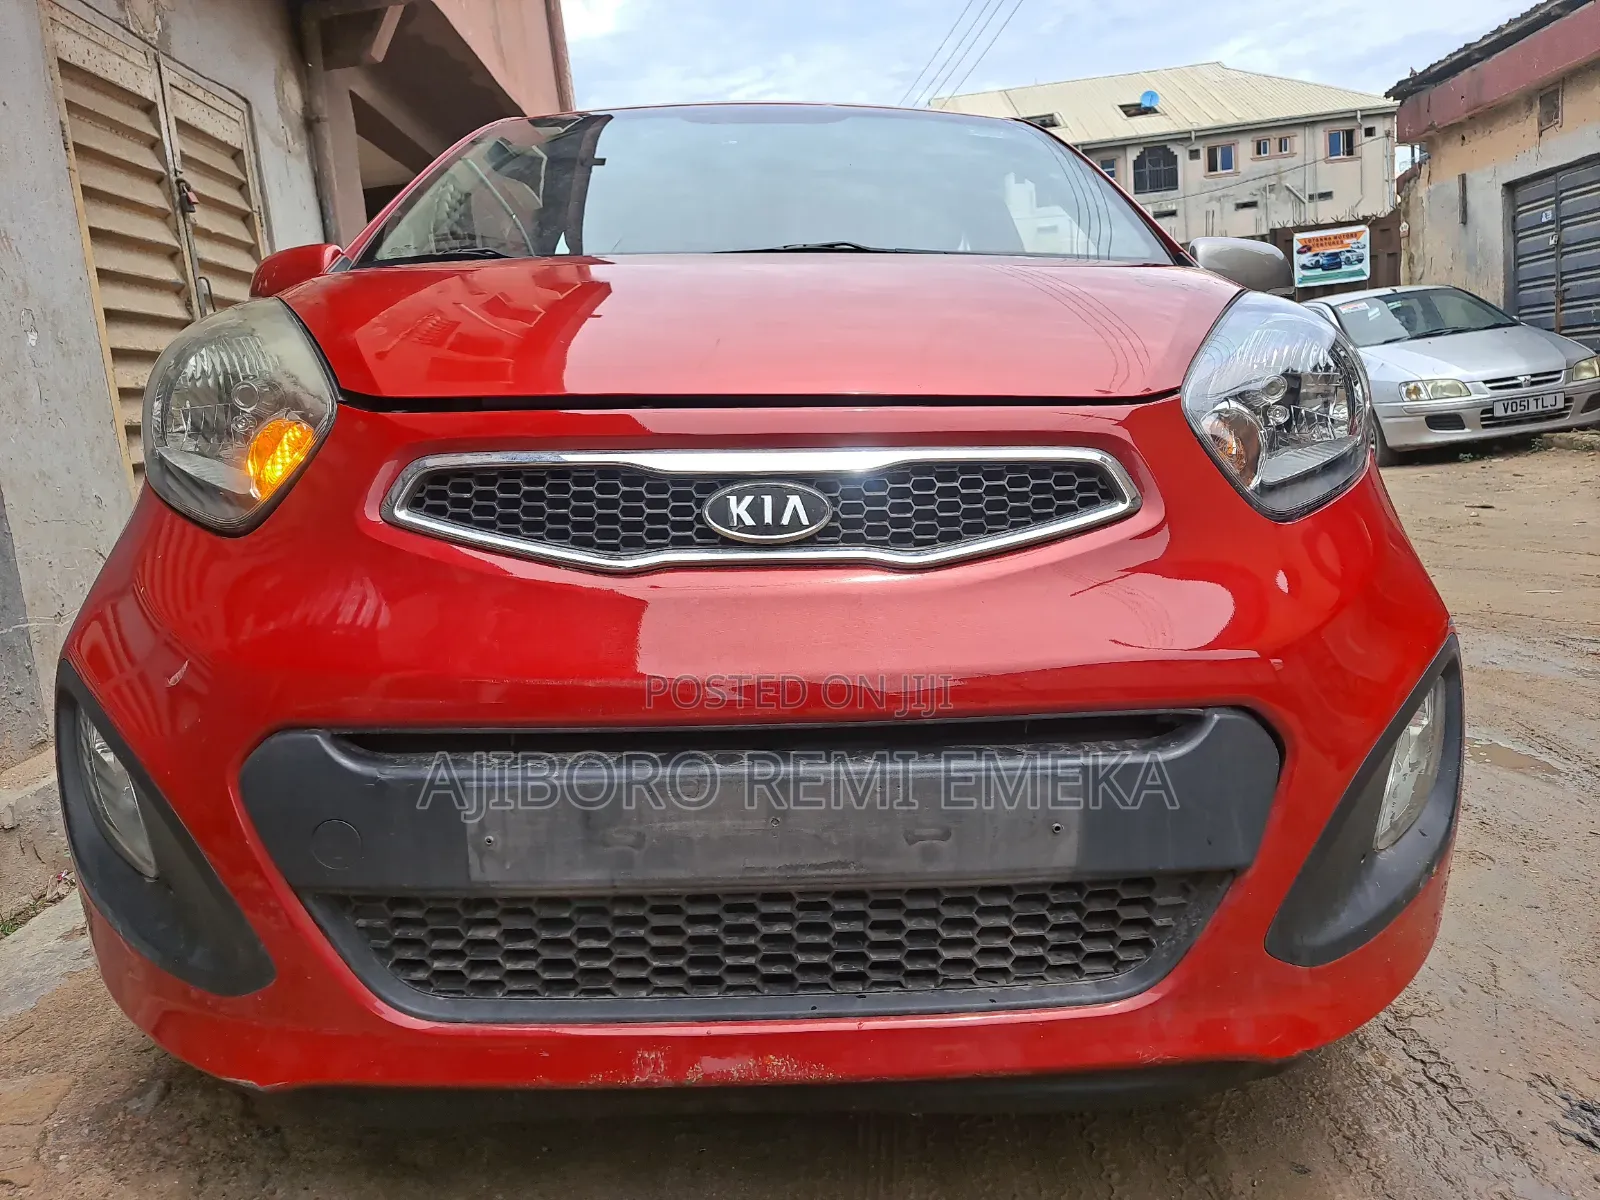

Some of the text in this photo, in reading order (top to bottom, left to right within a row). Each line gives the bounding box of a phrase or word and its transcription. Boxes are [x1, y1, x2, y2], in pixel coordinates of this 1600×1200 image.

[1333, 232, 1357, 240] MOTORS
[1533, 395, 1557, 410] TLJ
[726, 495, 810, 526] KIA
